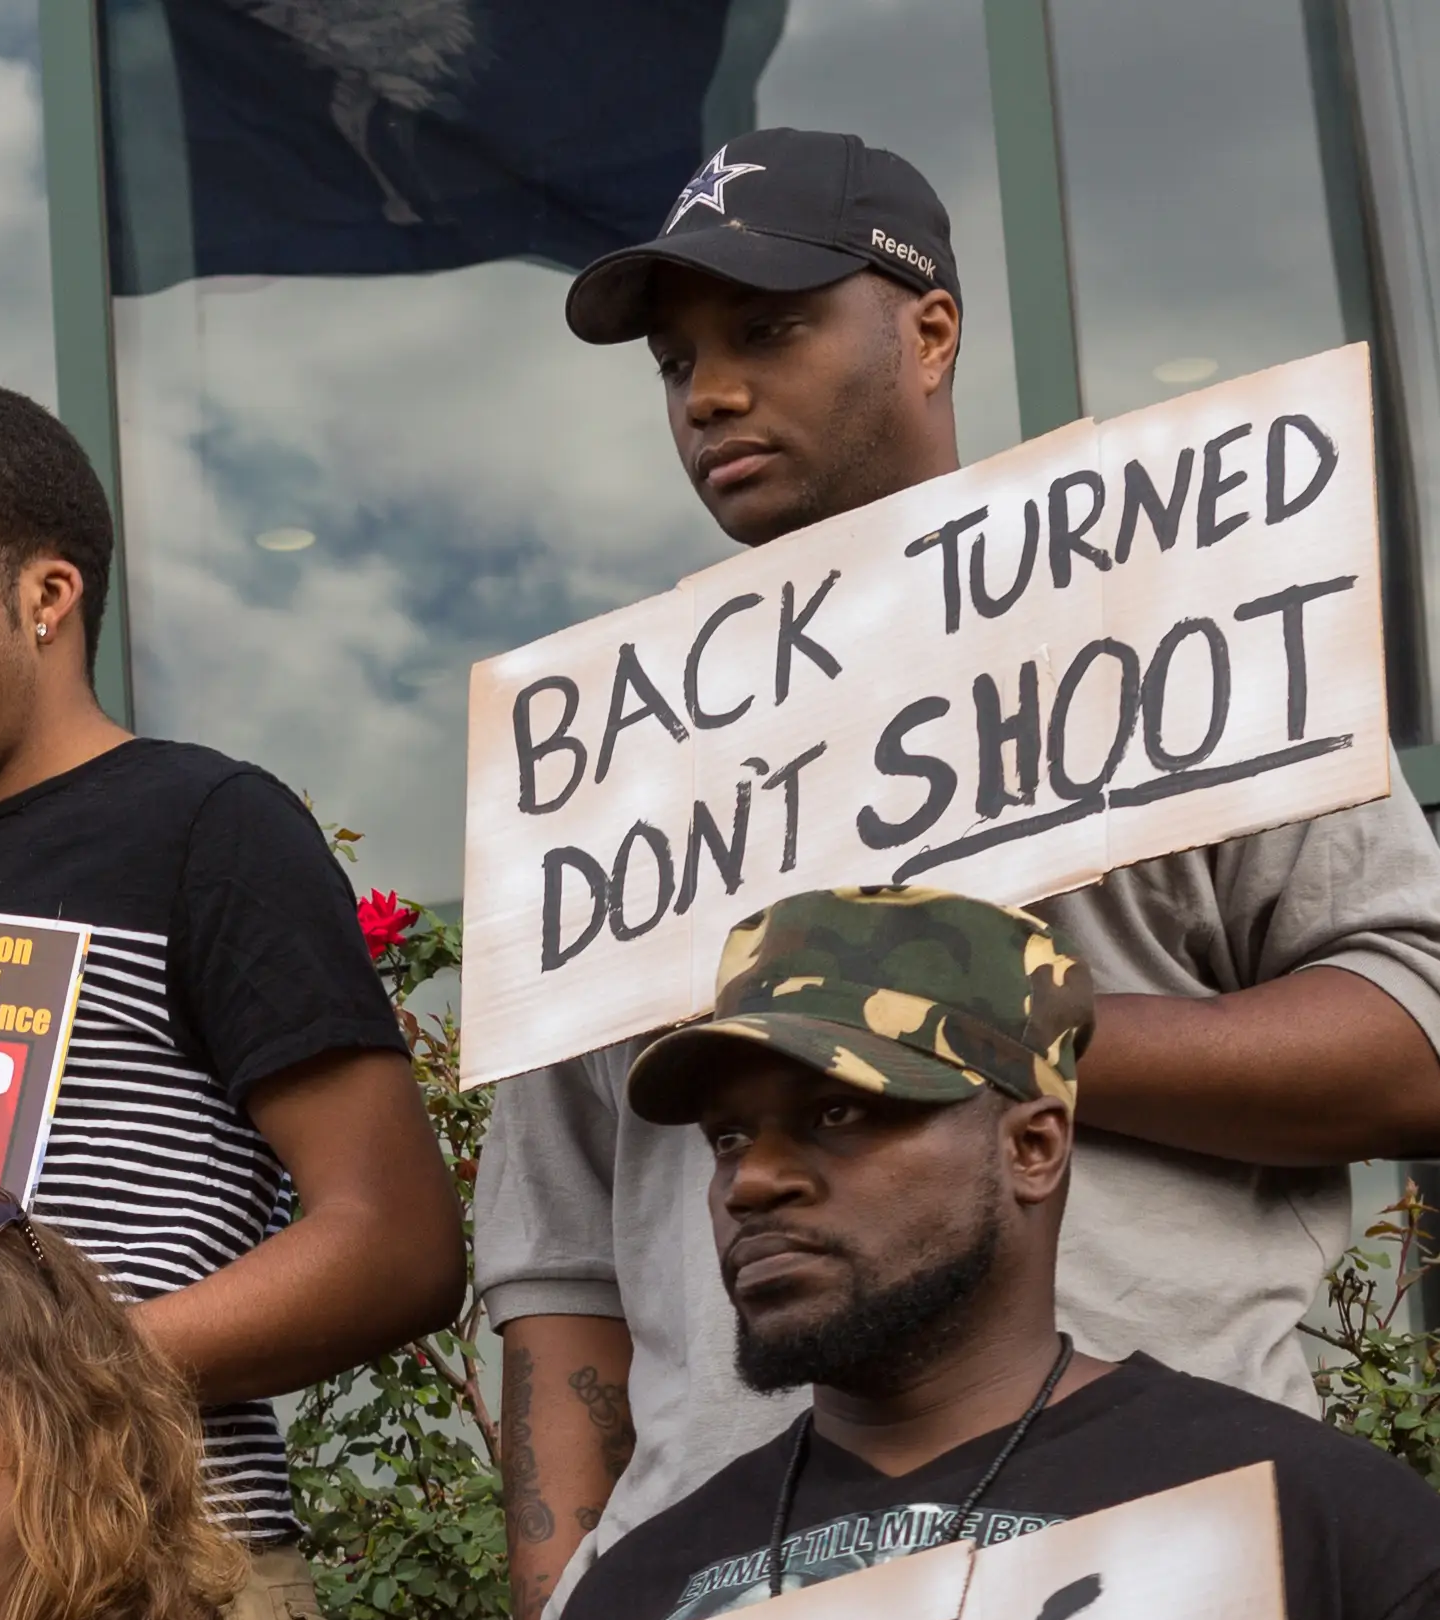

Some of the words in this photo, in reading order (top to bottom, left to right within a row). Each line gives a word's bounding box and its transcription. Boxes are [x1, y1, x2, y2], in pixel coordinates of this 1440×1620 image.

[871, 228, 936, 280] Reebok
[512, 570, 841, 815] BACK
[906, 415, 1339, 635] TURNED
[541, 741, 827, 972] DON'T
[856, 576, 1358, 851] SHOOT
[804, 1518, 873, 1565] TILL
[878, 1511, 983, 1549] MIKE
